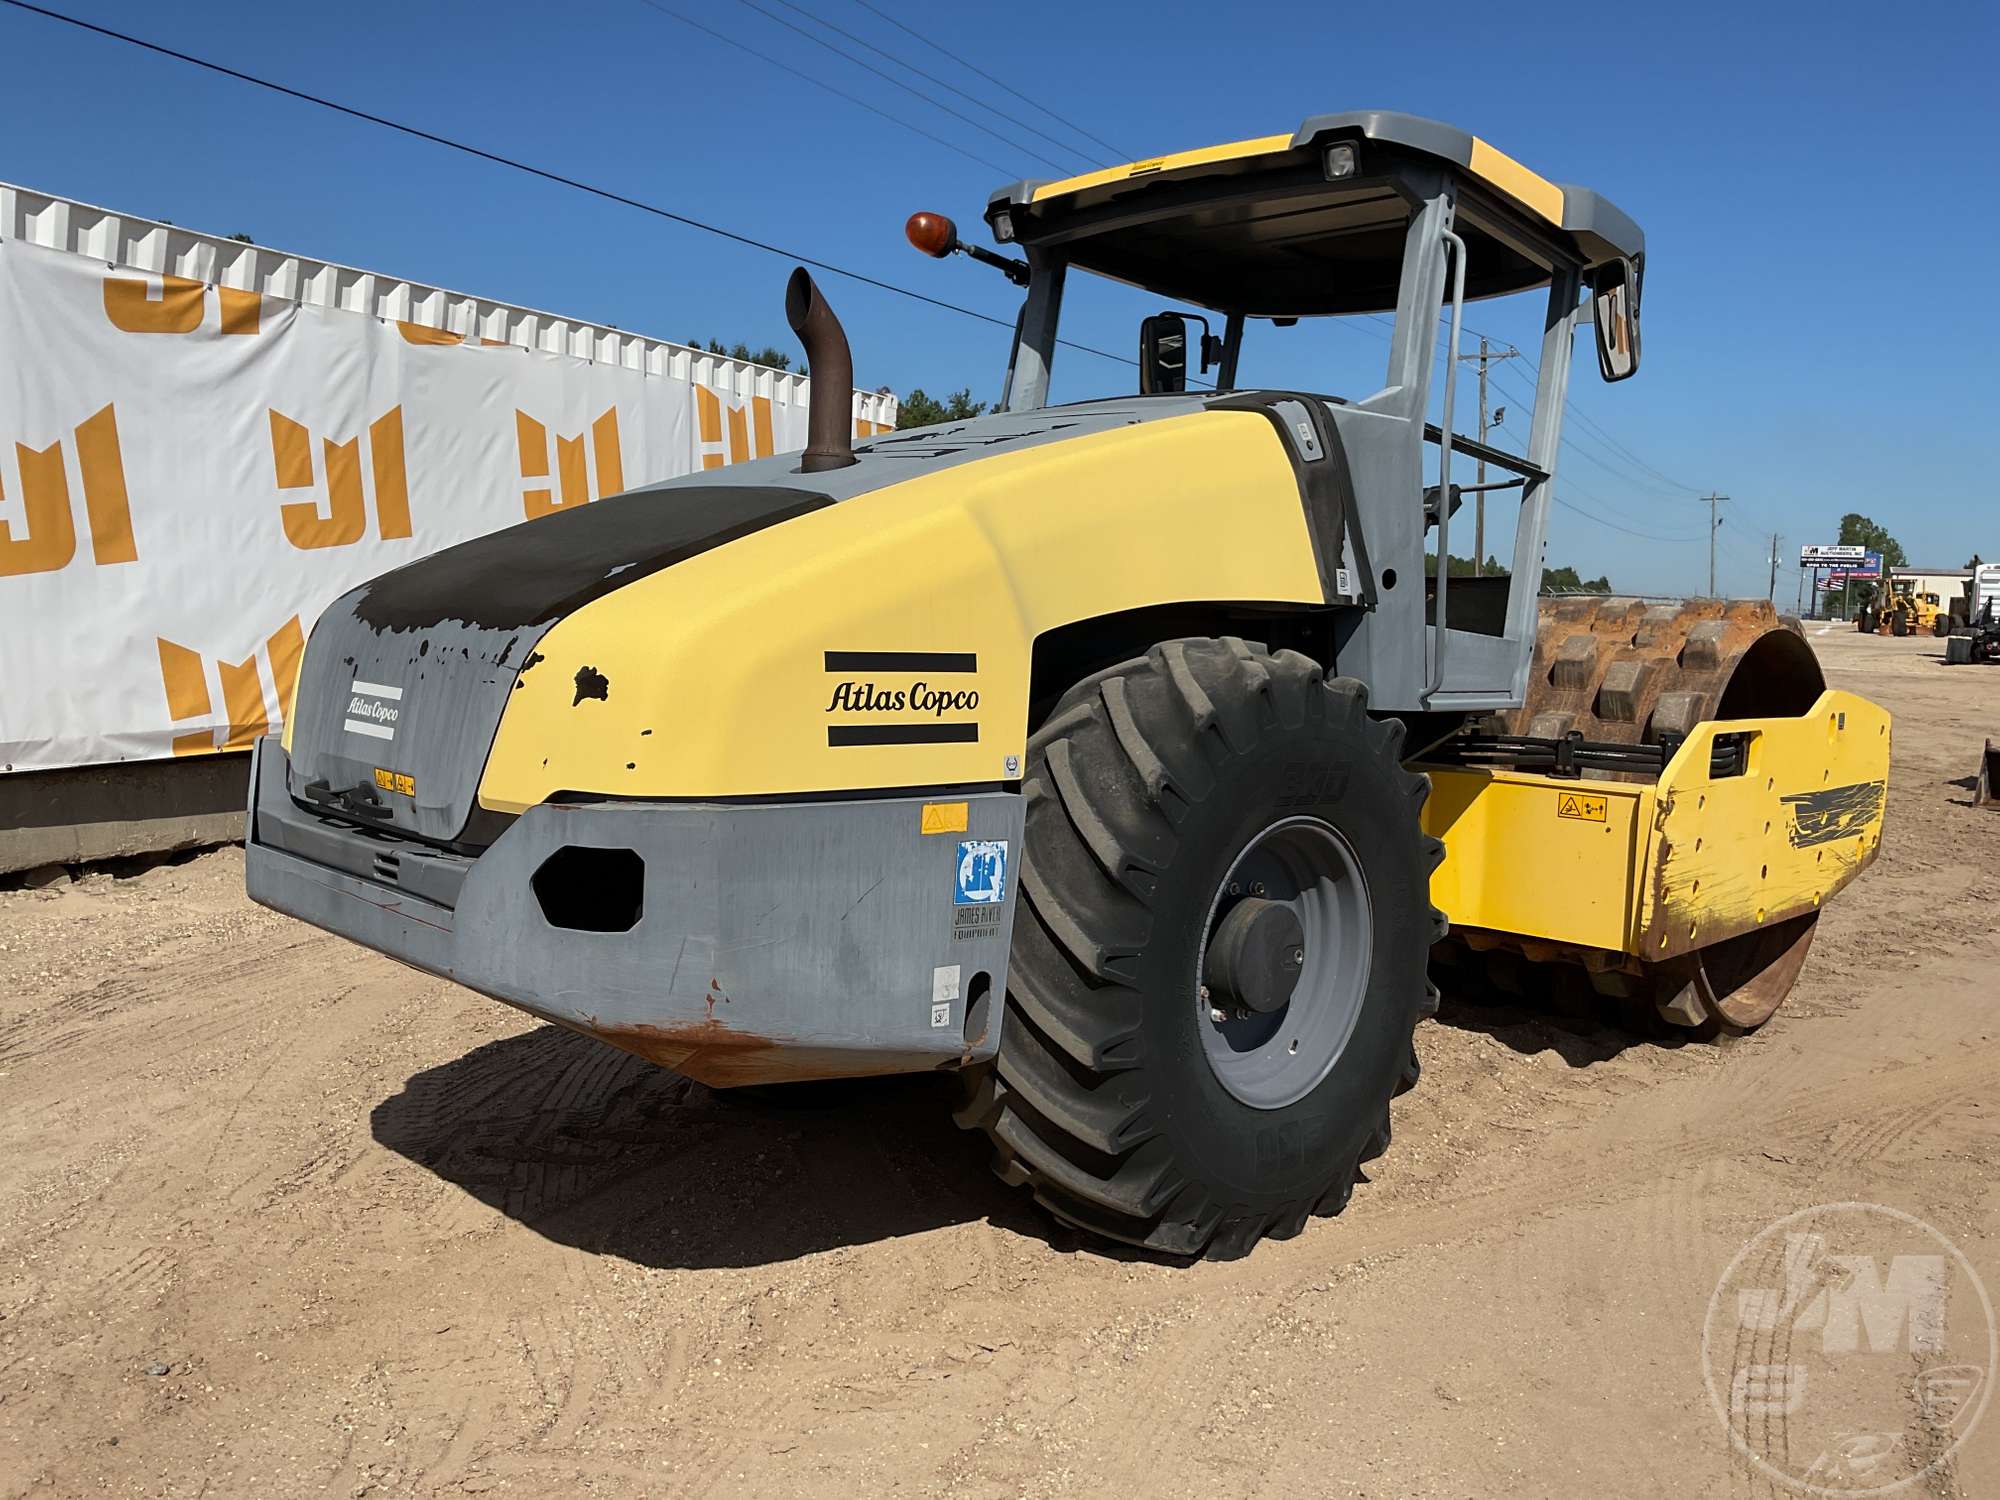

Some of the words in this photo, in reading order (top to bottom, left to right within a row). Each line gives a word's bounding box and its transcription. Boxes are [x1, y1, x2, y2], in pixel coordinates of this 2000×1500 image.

[347, 697, 372, 717] Atlas
[372, 701, 399, 722] Copco
[826, 682, 905, 712] Atlas
[909, 682, 979, 717] Copco
[954, 907, 980, 925] JAMES
